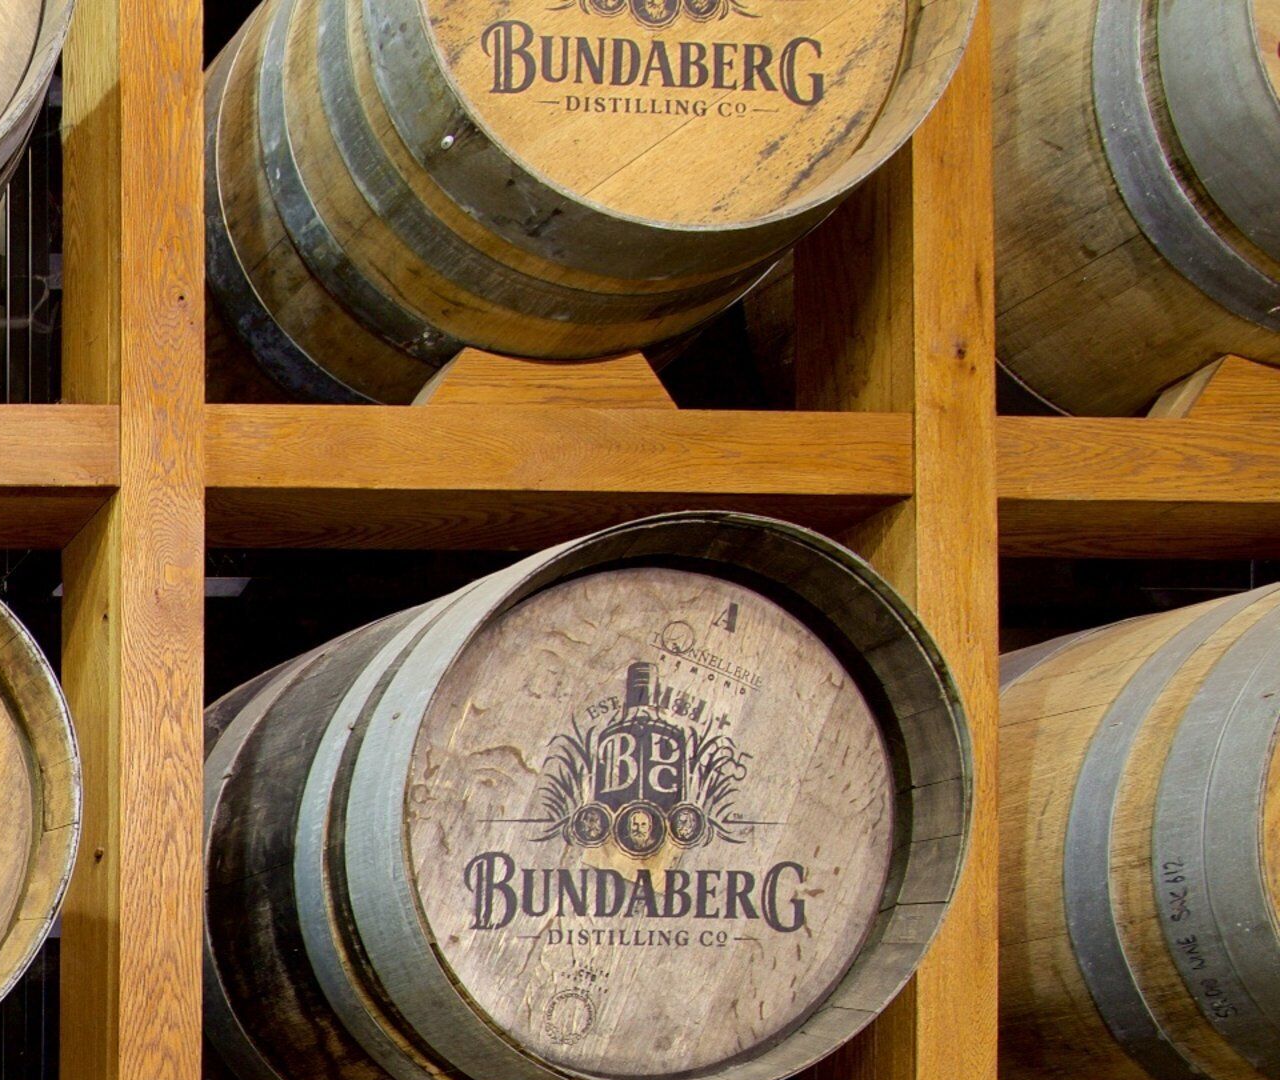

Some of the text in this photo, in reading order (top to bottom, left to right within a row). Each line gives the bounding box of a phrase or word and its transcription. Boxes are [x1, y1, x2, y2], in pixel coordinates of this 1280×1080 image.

[481, 20, 824, 106] BUNDABERG
[565, 95, 707, 117] DISTILLING
[712, 602, 739, 634] A
[586, 695, 622, 719] EST.
[463, 851, 807, 933] BUNDABERG
[547, 929, 690, 947] DISTILLING
